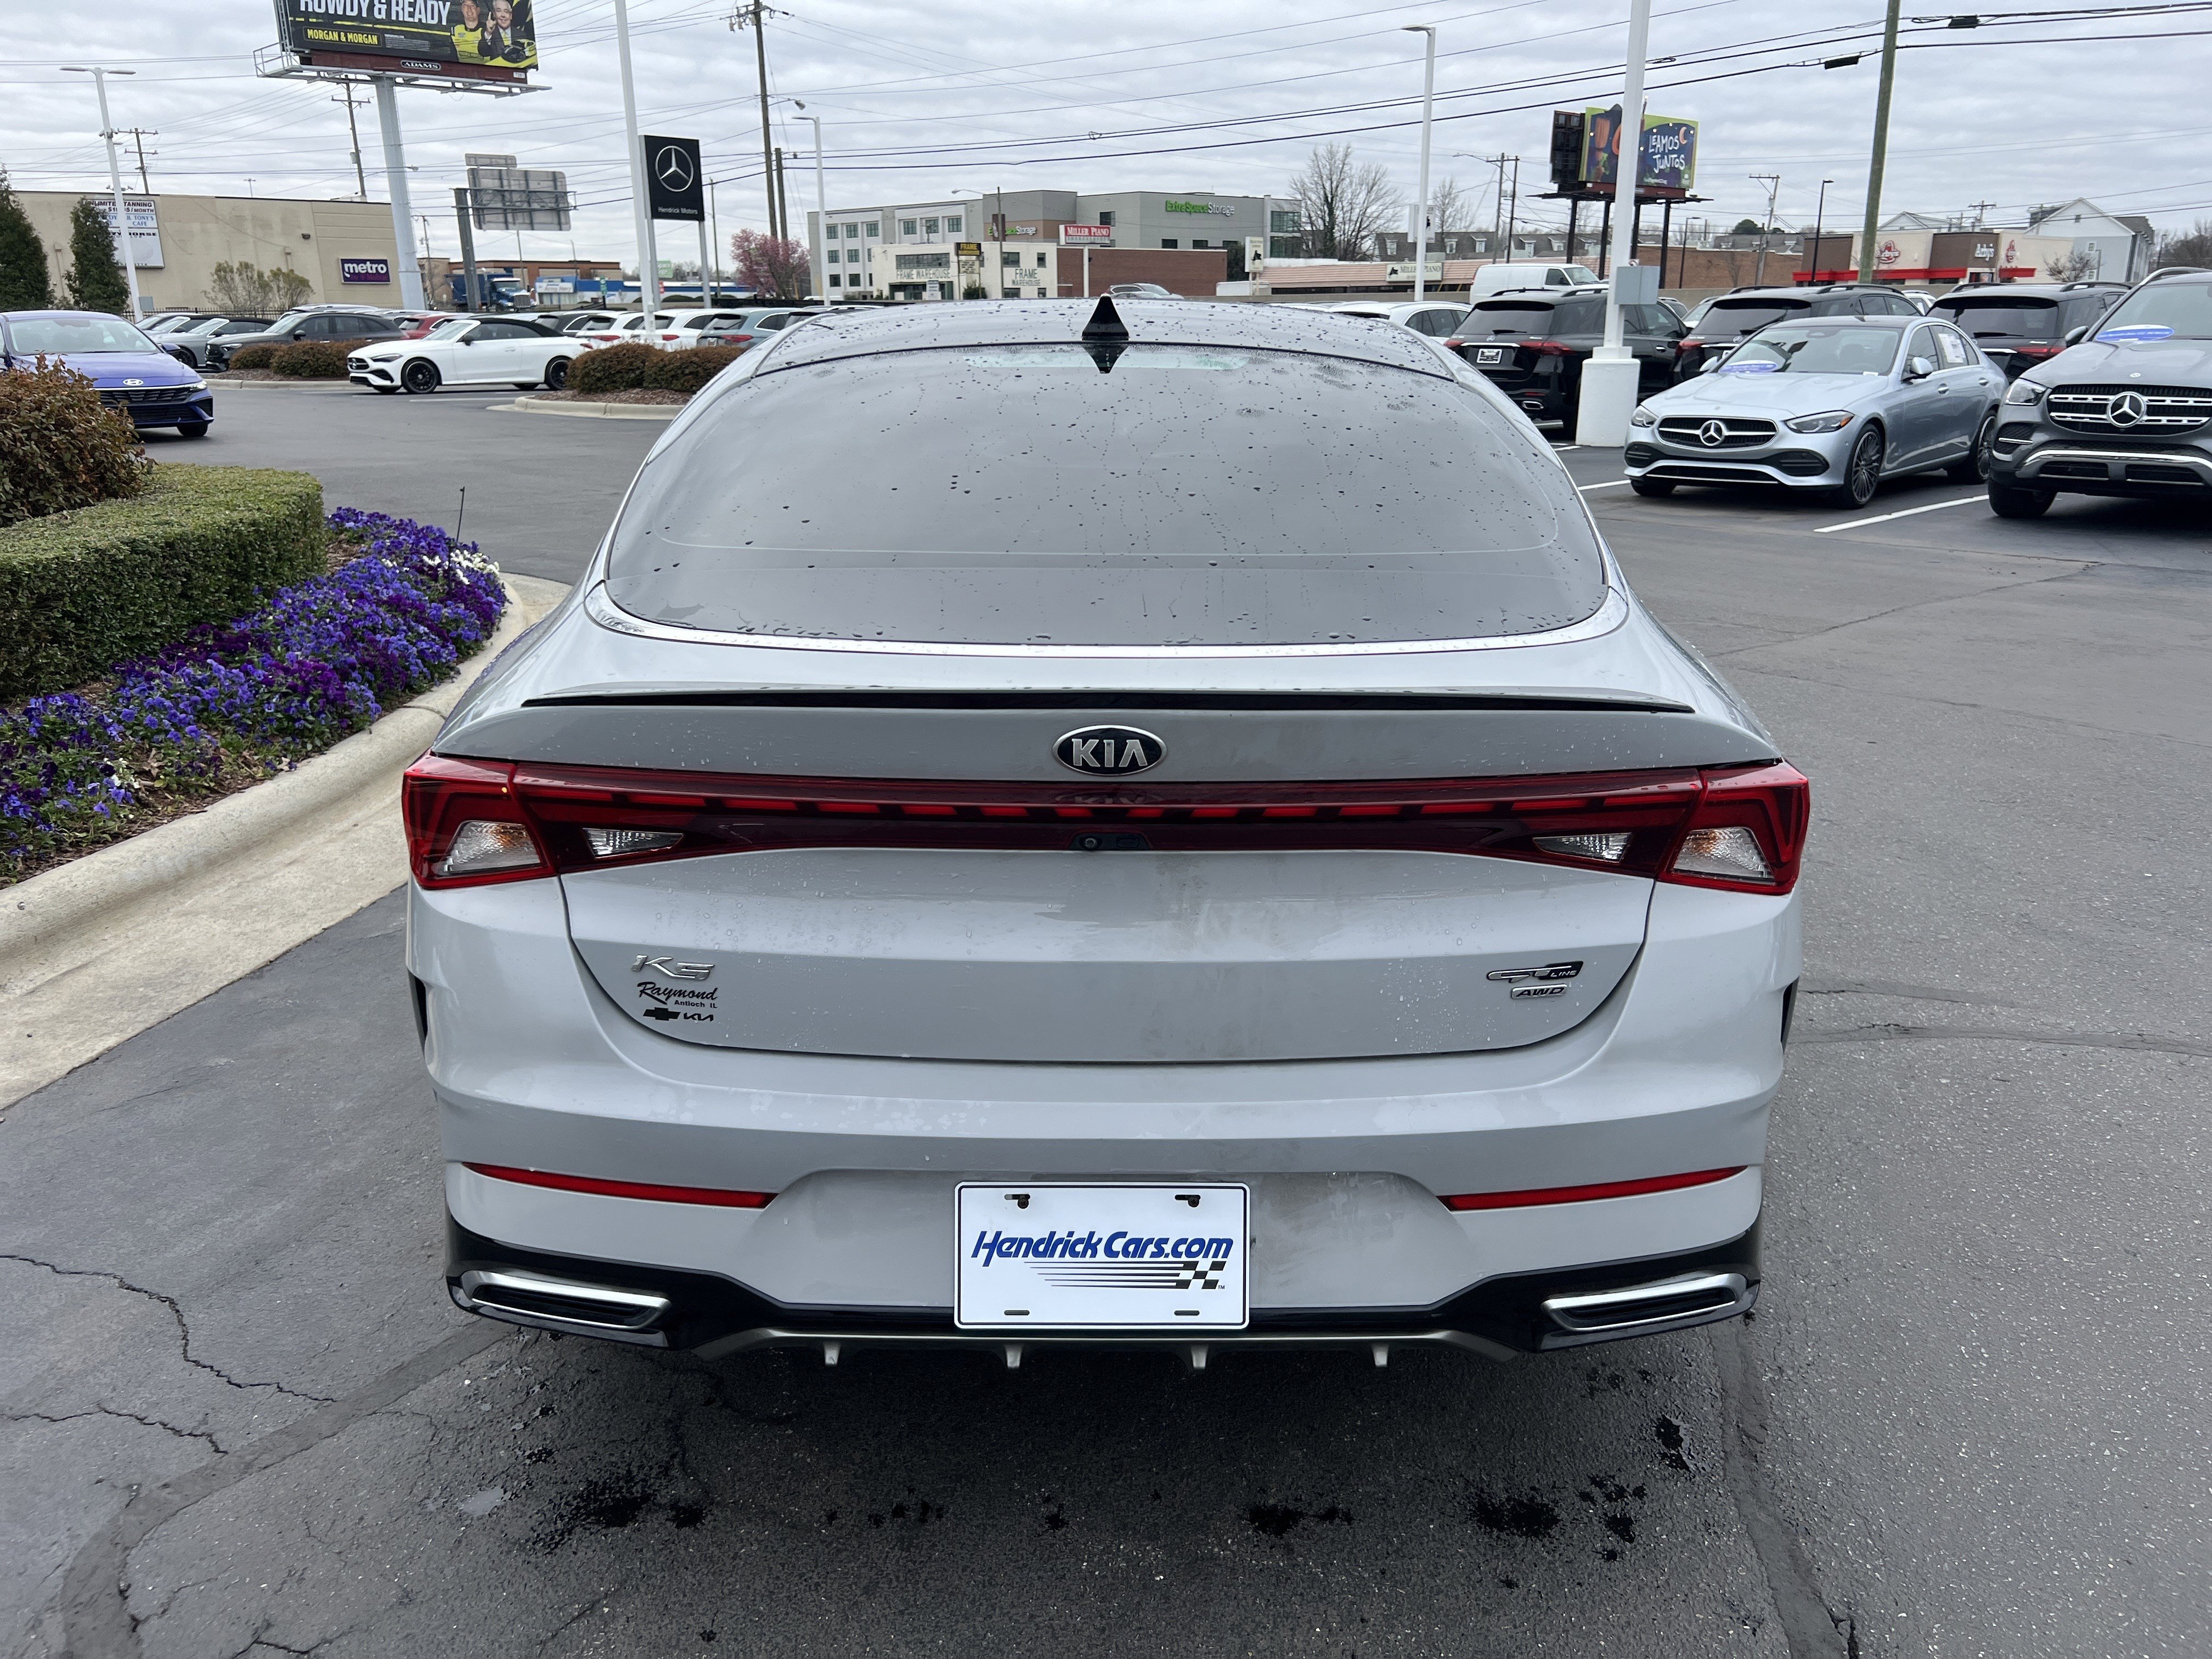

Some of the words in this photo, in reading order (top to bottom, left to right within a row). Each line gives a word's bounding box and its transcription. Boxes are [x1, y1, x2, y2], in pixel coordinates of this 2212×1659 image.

[374, 0, 386, 19] &
[391, 0, 450, 26] READY
[307, 29, 338, 42] MORGAN
[341, 33, 346, 42] &
[347, 33, 378, 45] MORGAN
[403, 61, 438, 70] ADAMS
[1649, 135, 1679, 153] LEAMOS
[1067, 226, 1089, 236] MILLER
[1091, 227, 1109, 236] PIANO
[344, 261, 387, 274] metro
[896, 269, 914, 279] FRAME
[916, 268, 951, 279] WAREHOUSE
[1014, 268, 1038, 279] FRAME
[1400, 265, 1416, 273] MILLE
[1071, 738, 1148, 767] KIA
[631, 955, 715, 980] K5
[637, 981, 718, 1005] Raymond
[1515, 987, 1562, 997] AWD
[674, 1000, 706, 1008] Antioch
